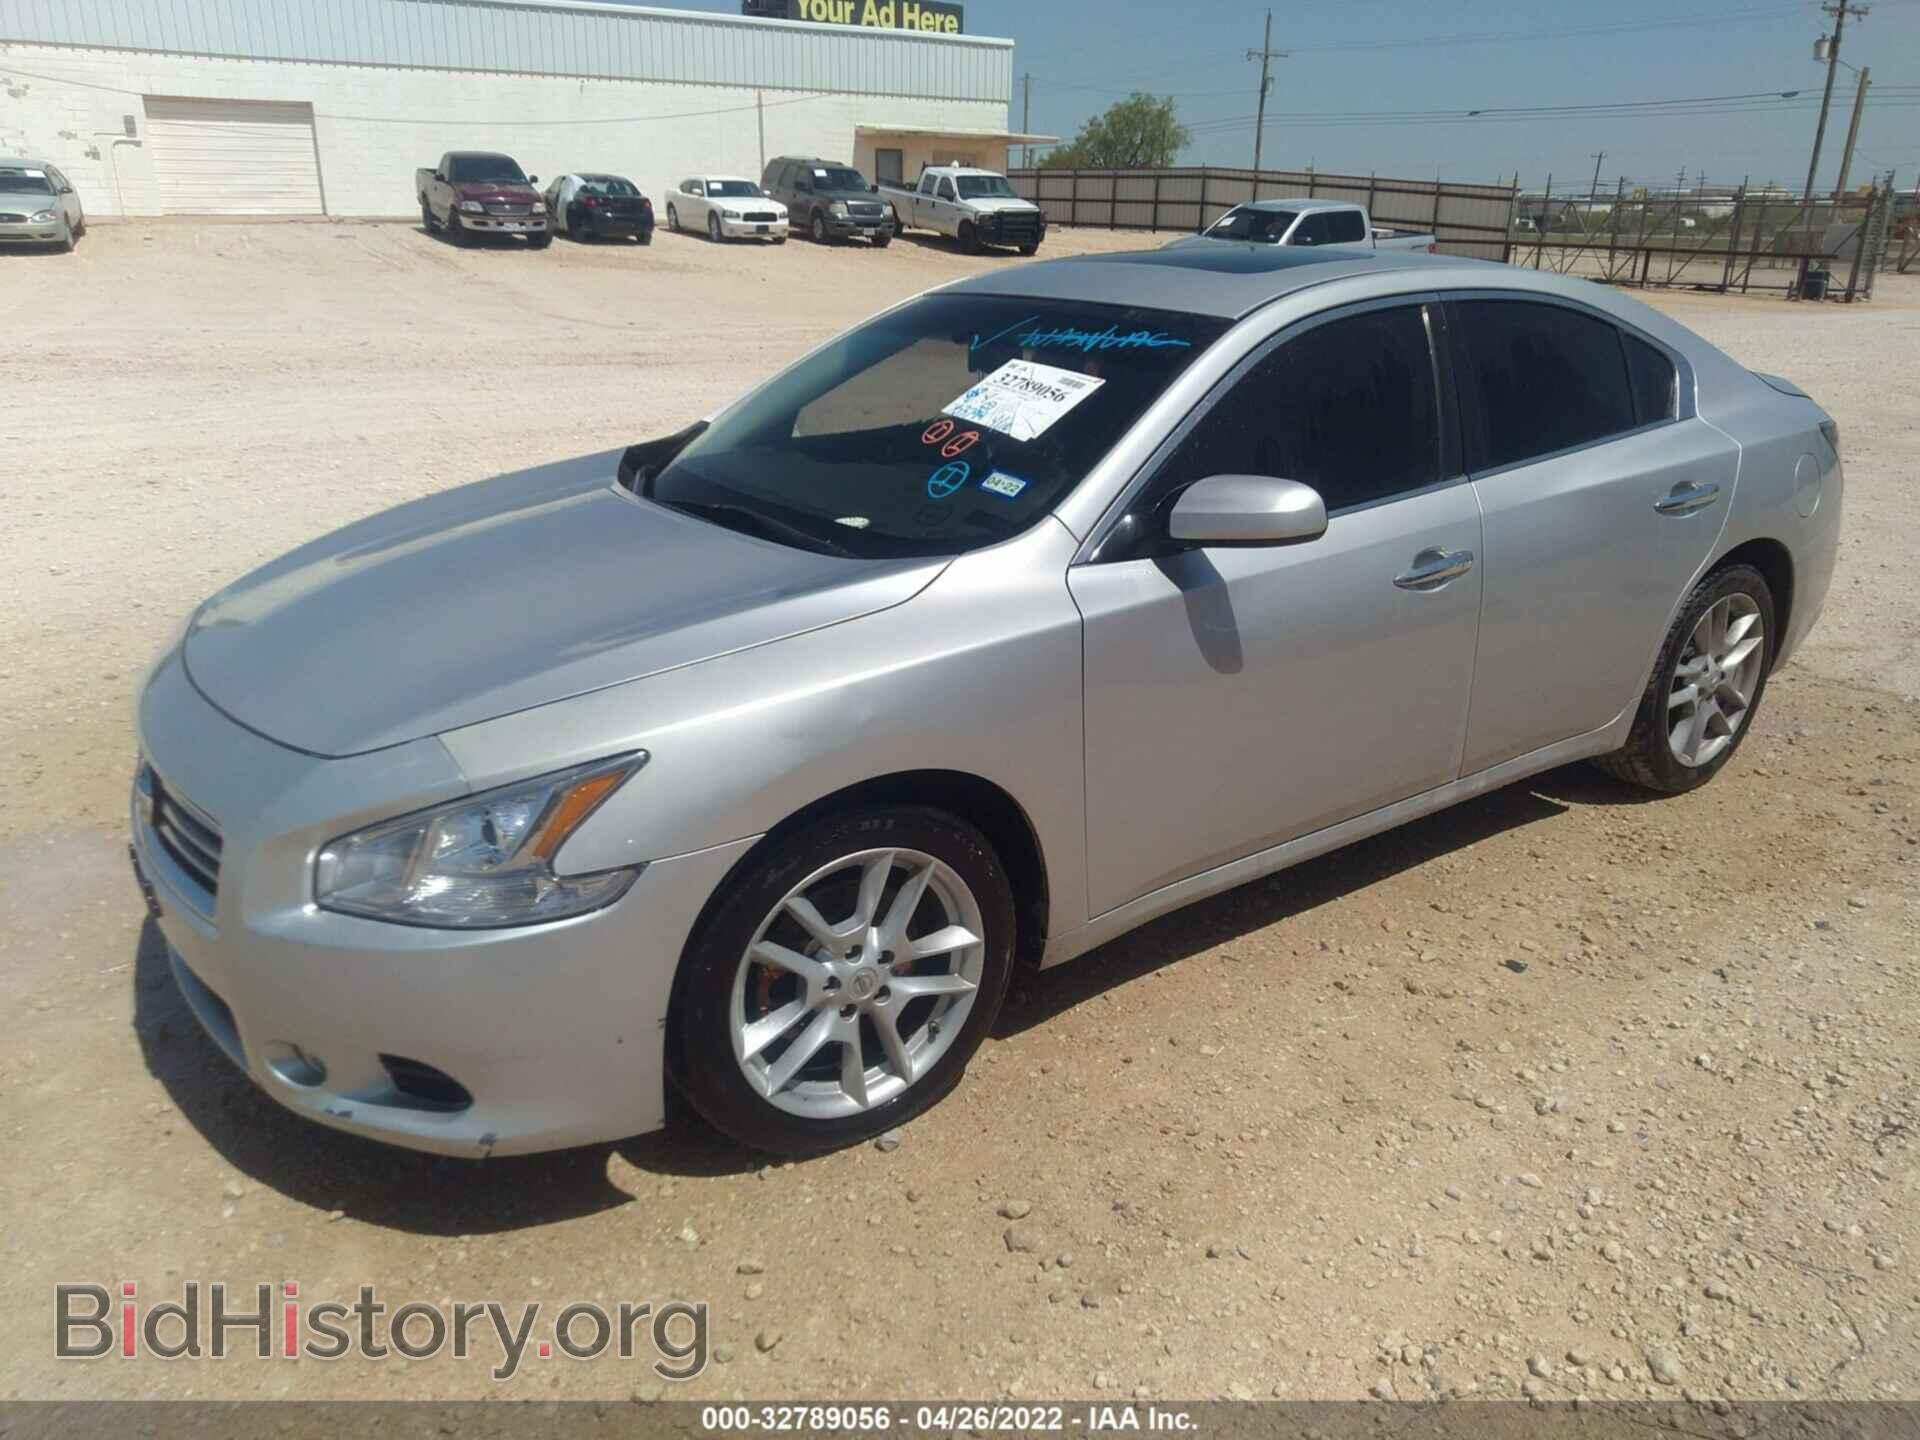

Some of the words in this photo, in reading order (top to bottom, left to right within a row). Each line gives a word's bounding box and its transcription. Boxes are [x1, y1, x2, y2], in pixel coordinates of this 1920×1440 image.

[798, 0, 854, 23] Your
[861, 0, 896, 29] Ad
[903, 2, 959, 34] Here
[992, 372, 1068, 403] 32789056
